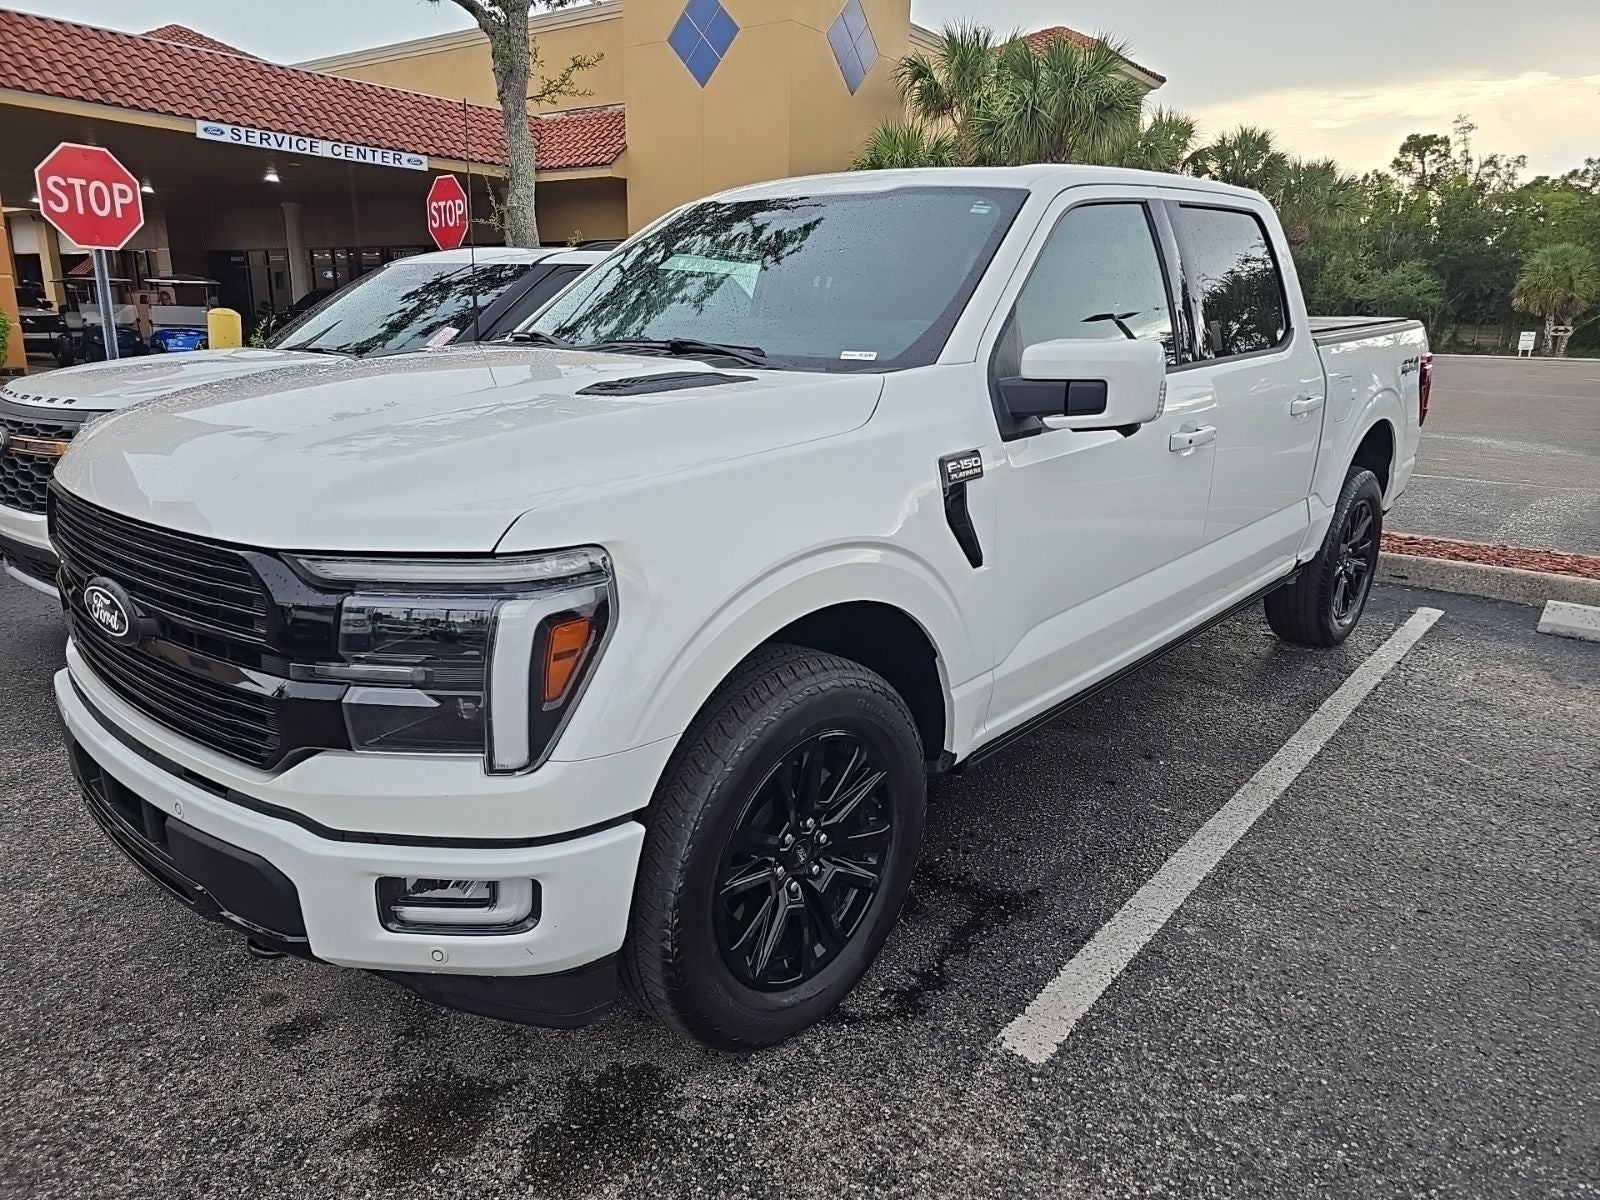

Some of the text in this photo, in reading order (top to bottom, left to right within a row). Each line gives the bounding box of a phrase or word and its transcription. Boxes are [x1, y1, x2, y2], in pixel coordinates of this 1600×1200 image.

[206, 127, 222, 135] Ford
[230, 127, 320, 153] SERVICE
[331, 143, 403, 165] CENTER
[46, 175, 134, 218] STOP
[430, 199, 465, 228] STOP
[947, 457, 981, 473] F-150
[951, 467, 981, 480] PLATINUM
[92, 591, 120, 631] Ford
